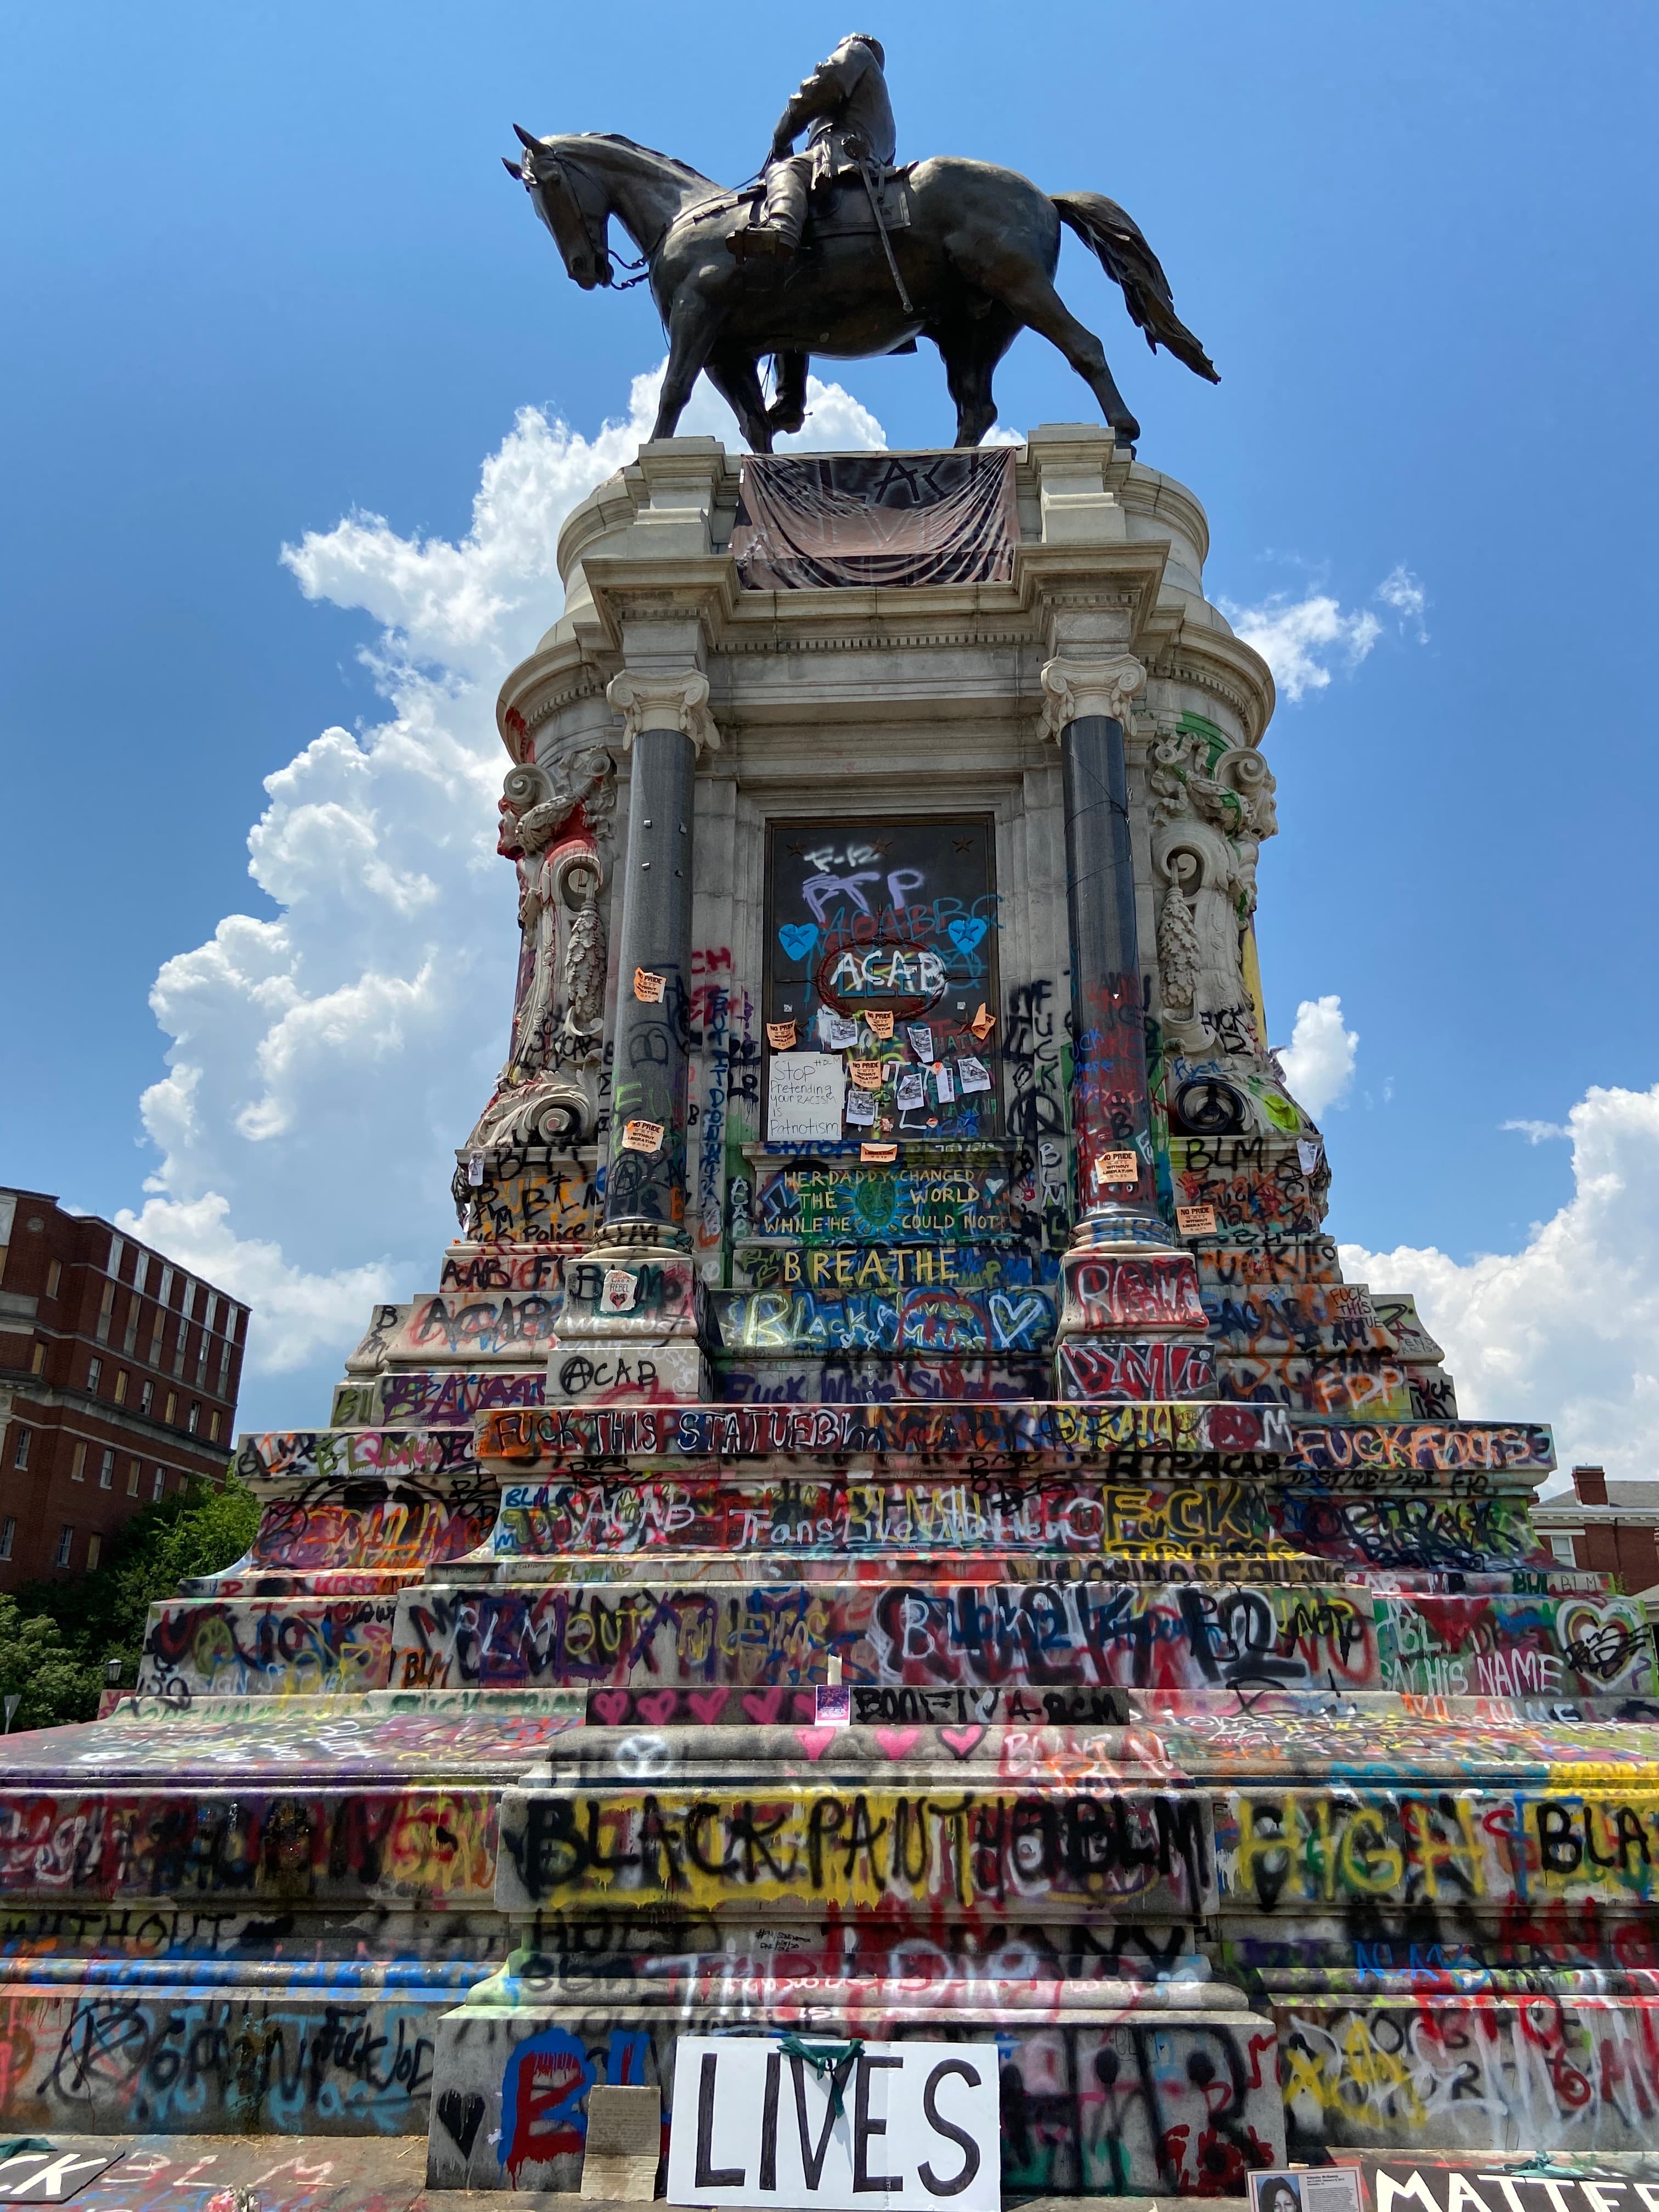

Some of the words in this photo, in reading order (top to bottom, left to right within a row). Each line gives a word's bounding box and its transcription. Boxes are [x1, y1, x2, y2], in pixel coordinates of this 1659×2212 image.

[644, 975, 662, 984] PRIDE
[774, 1060, 816, 1082] Stop
[770, 1080, 832, 1098] Pretending
[770, 1094, 793, 1107] your
[797, 1095, 836, 1105] RACISM
[633, 1132, 654, 1141] WITHOUT
[642, 1122, 661, 1133] PRIDE
[628, 1136, 656, 1146] LIBERATION
[1186, 1136, 1264, 1172] BLM
[785, 1171, 825, 1186] HER
[828, 1170, 891, 1185] DADDY
[899, 1169, 974, 1183] CHANGED
[798, 1192, 838, 1210] THE
[910, 1188, 980, 1205] WORLD
[764, 1216, 824, 1234] WHILE
[829, 1216, 851, 1233] HE
[902, 1214, 955, 1231] COULD
[964, 1214, 999, 1230] NOT
[785, 1249, 959, 1284] BREATHE
[569, 1263, 665, 1308] BM
[610, 1283, 630, 1292] REBEL
[1330, 1287, 1368, 1306] FUCK
[1336, 1302, 1371, 1316] THIS
[1402, 1345, 1442, 1355] RACISM
[494, 1410, 583, 1455] FUCK
[585, 1410, 658, 1455] THIS
[677, 1408, 815, 1454] STATUE
[1296, 1426, 1412, 1469] FUCK
[729, 1510, 834, 1550] Trans
[1560, 1575, 1598, 1592] BLM
[404, 1651, 454, 1689] BLM
[1477, 1647, 1565, 1697] NAME
[696, 2052, 981, 2197] LIVES
